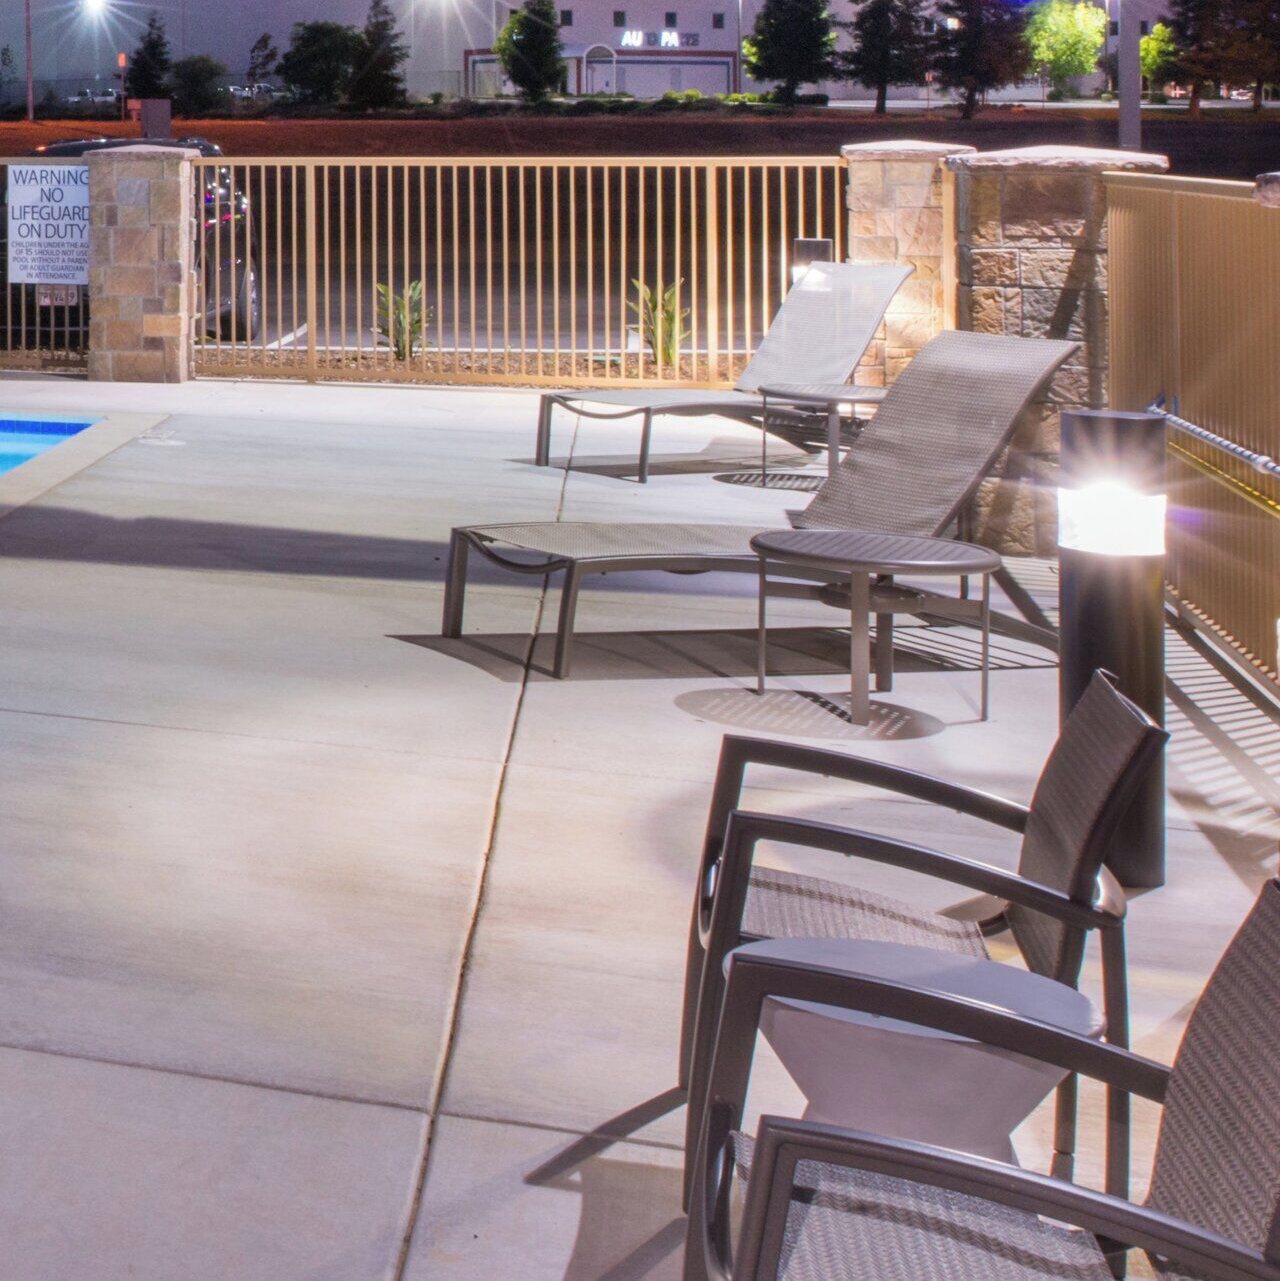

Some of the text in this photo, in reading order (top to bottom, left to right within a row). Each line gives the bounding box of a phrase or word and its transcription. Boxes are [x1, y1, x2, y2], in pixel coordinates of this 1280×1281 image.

[40, 187, 64, 203] NO
[18, 223, 87, 239] ON DUTY
